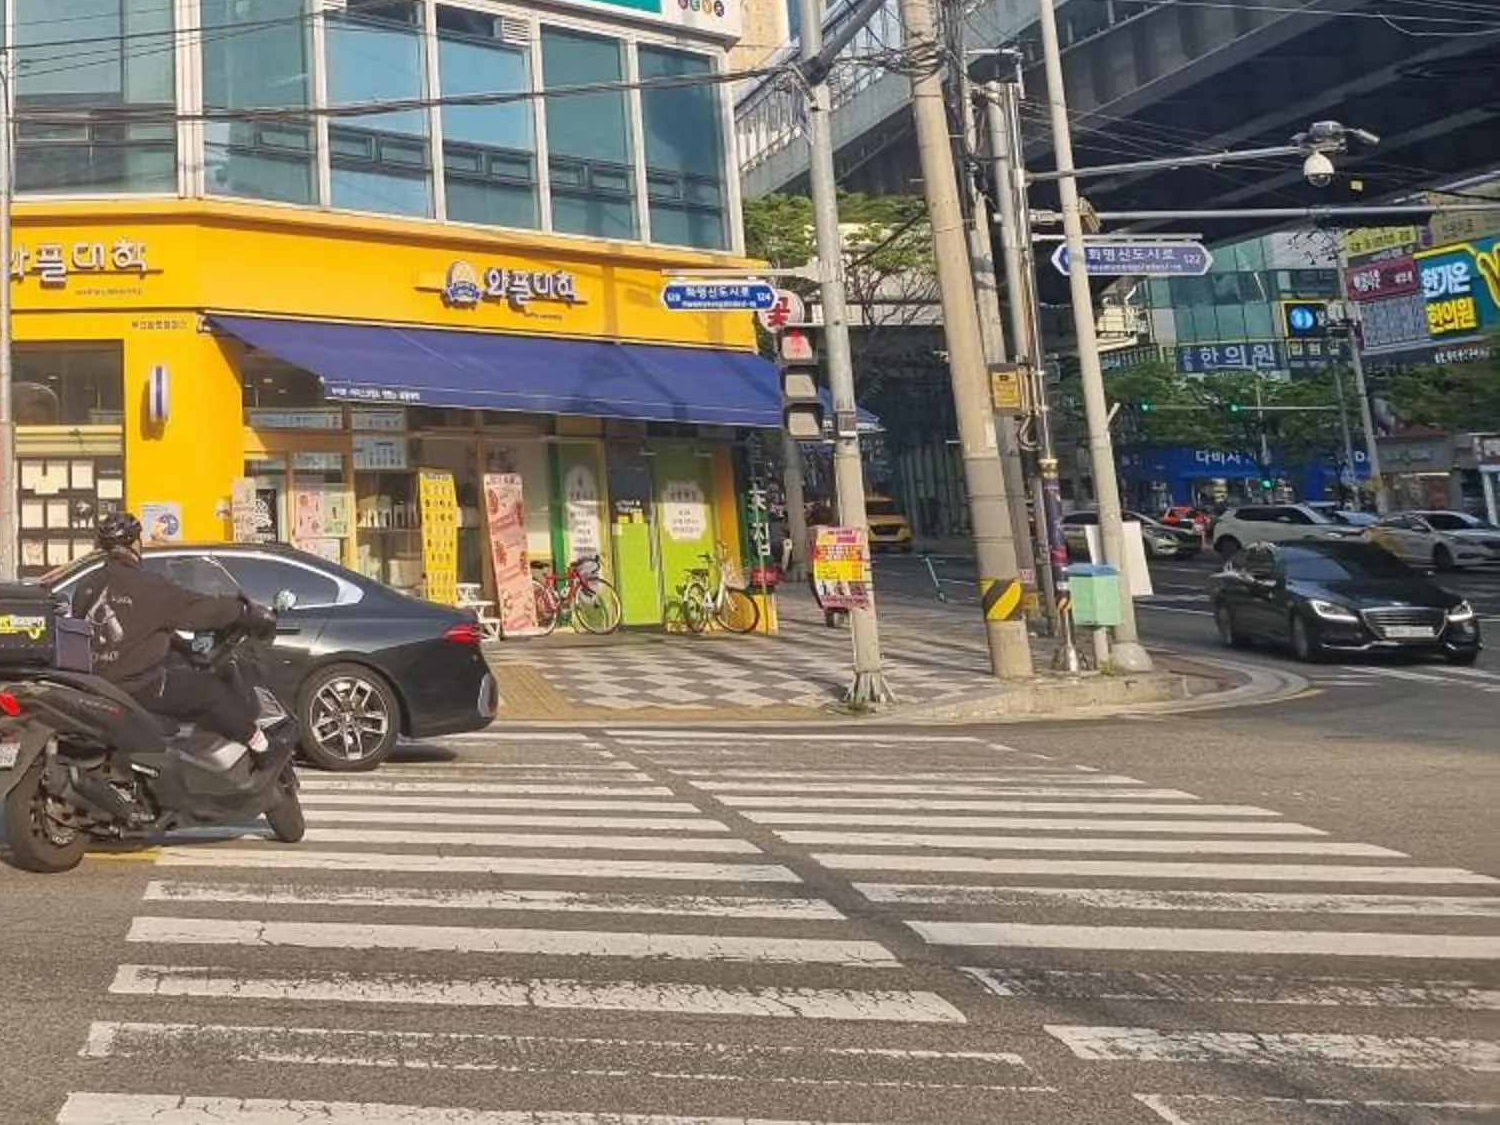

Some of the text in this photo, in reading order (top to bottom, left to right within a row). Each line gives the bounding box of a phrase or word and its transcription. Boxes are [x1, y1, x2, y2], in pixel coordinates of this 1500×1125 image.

[1087, 248, 1177, 262] 화명신도시로
[484, 267, 578, 306] 와플대학
[1425, 297, 1477, 335] 한의원
[1200, 343, 1278, 368] 한의원
